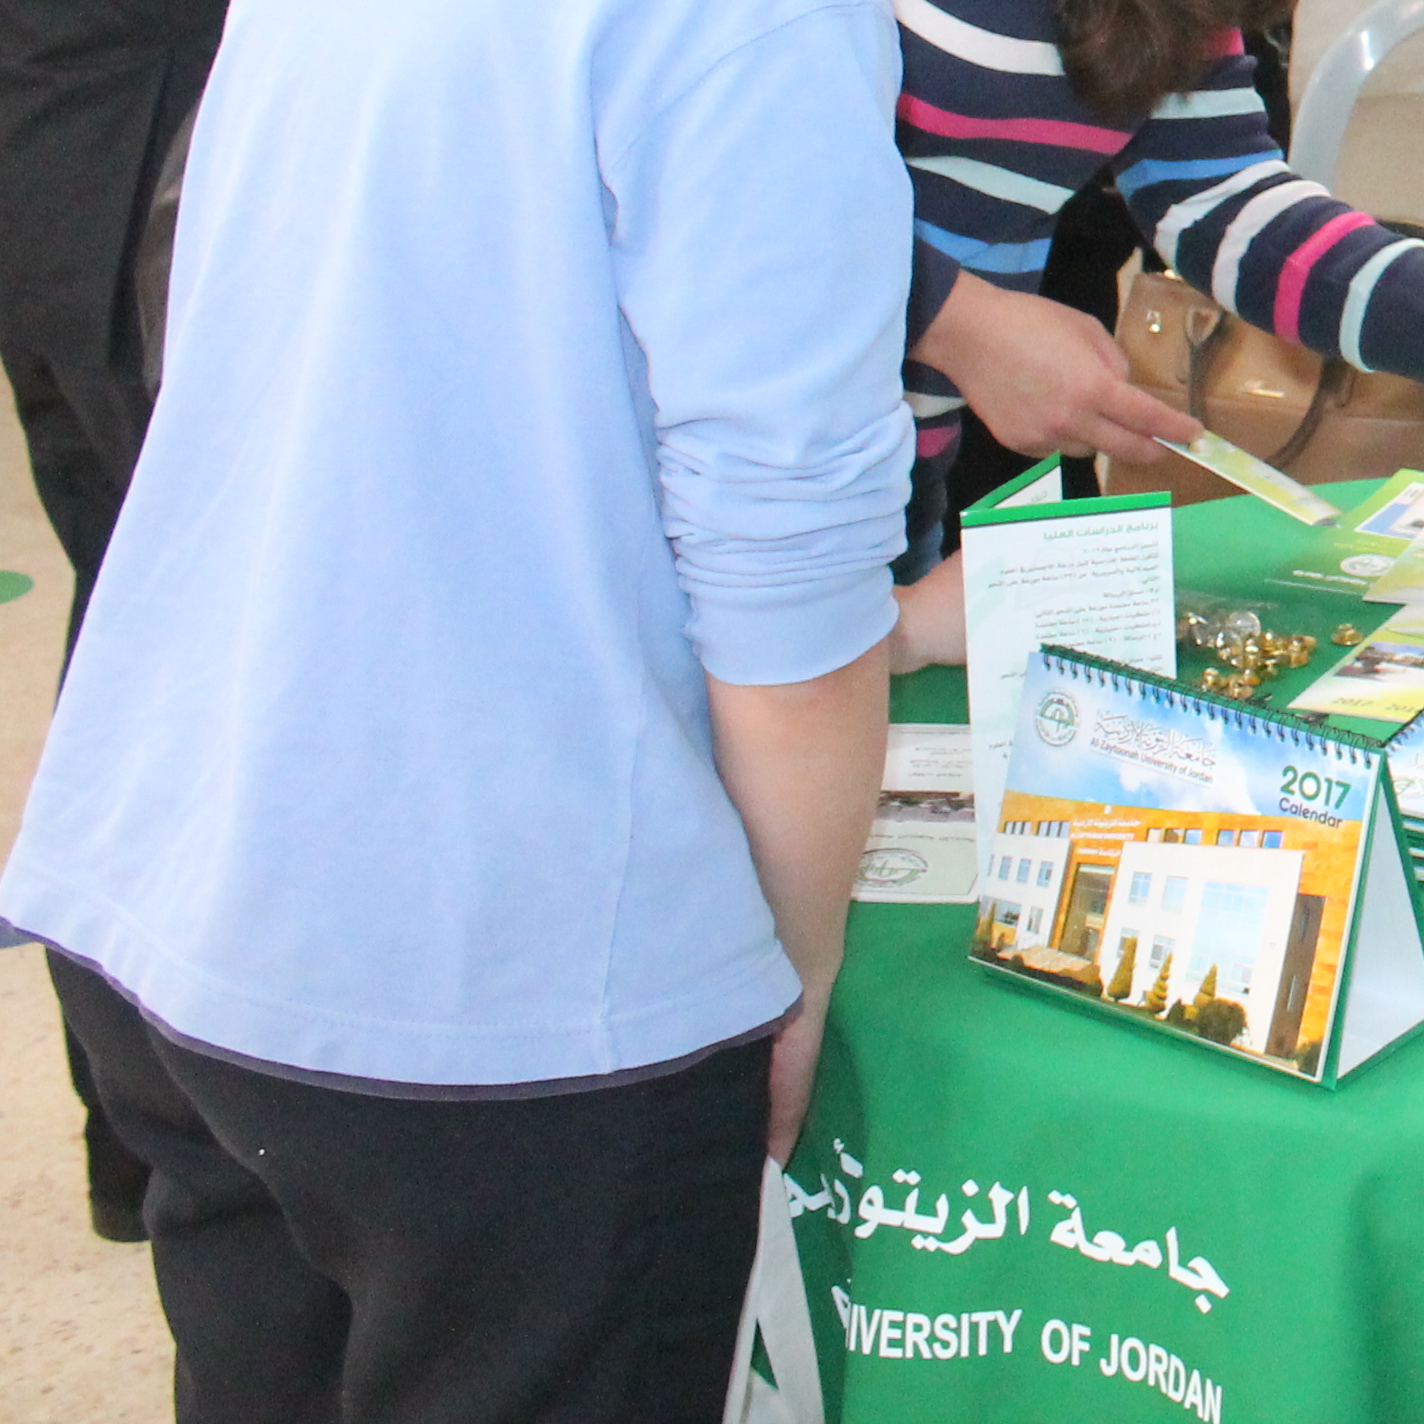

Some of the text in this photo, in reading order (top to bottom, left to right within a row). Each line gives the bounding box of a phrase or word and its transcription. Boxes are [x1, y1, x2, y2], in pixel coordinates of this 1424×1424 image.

[1140, 752, 1177, 775] University
[1280, 765, 1351, 810] 2017
[1279, 797, 1343, 828] Calendar
[1047, 1188, 1230, 1314] جامعة
[848, 1304, 1223, 1424] IVERSITY OF JORDAN
